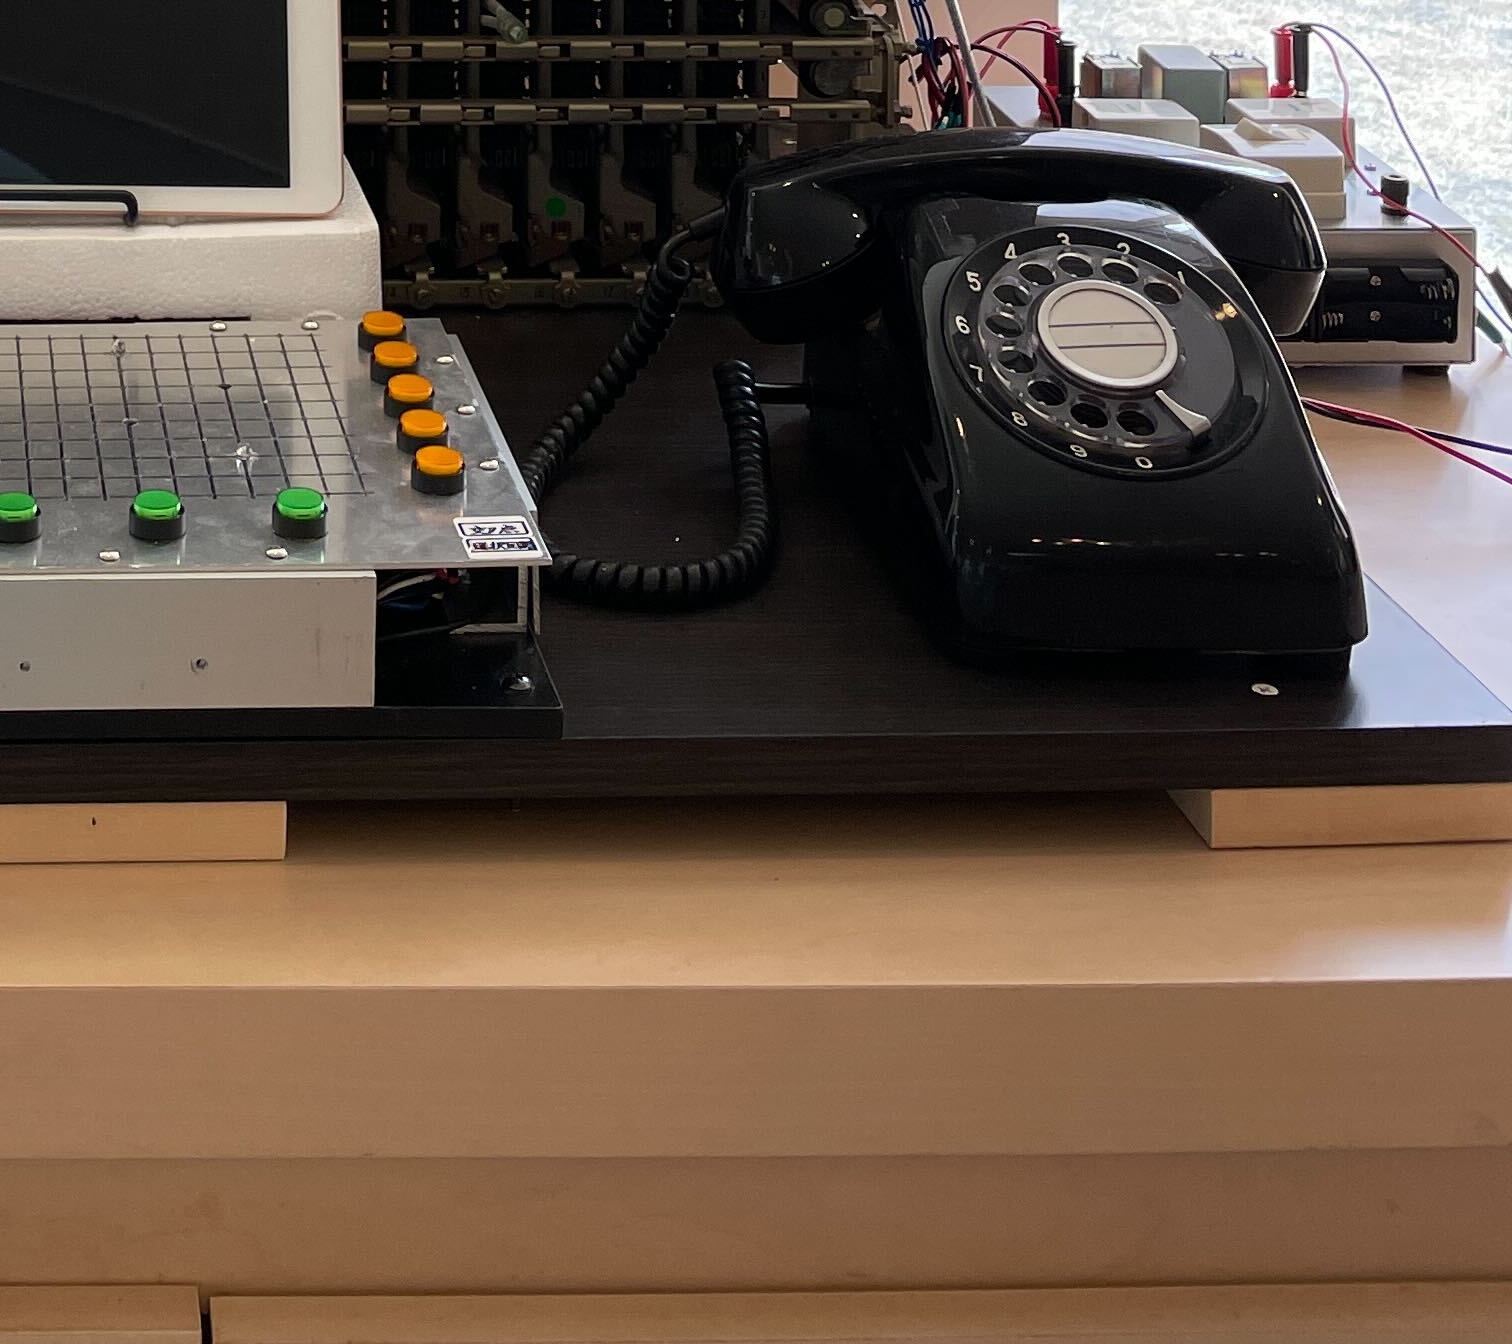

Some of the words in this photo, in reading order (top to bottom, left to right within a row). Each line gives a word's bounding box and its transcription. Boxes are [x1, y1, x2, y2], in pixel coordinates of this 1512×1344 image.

[1057, 233, 1070, 246] 3
[1004, 243, 1018, 260] 4
[1116, 243, 1131, 258] 2
[966, 272, 982, 292] 5
[954, 315, 970, 334] 6
[969, 365, 984, 382] 7
[1011, 412, 1028, 427] 8
[1070, 444, 1087, 458] 9
[1134, 456, 1153, 469] 0
